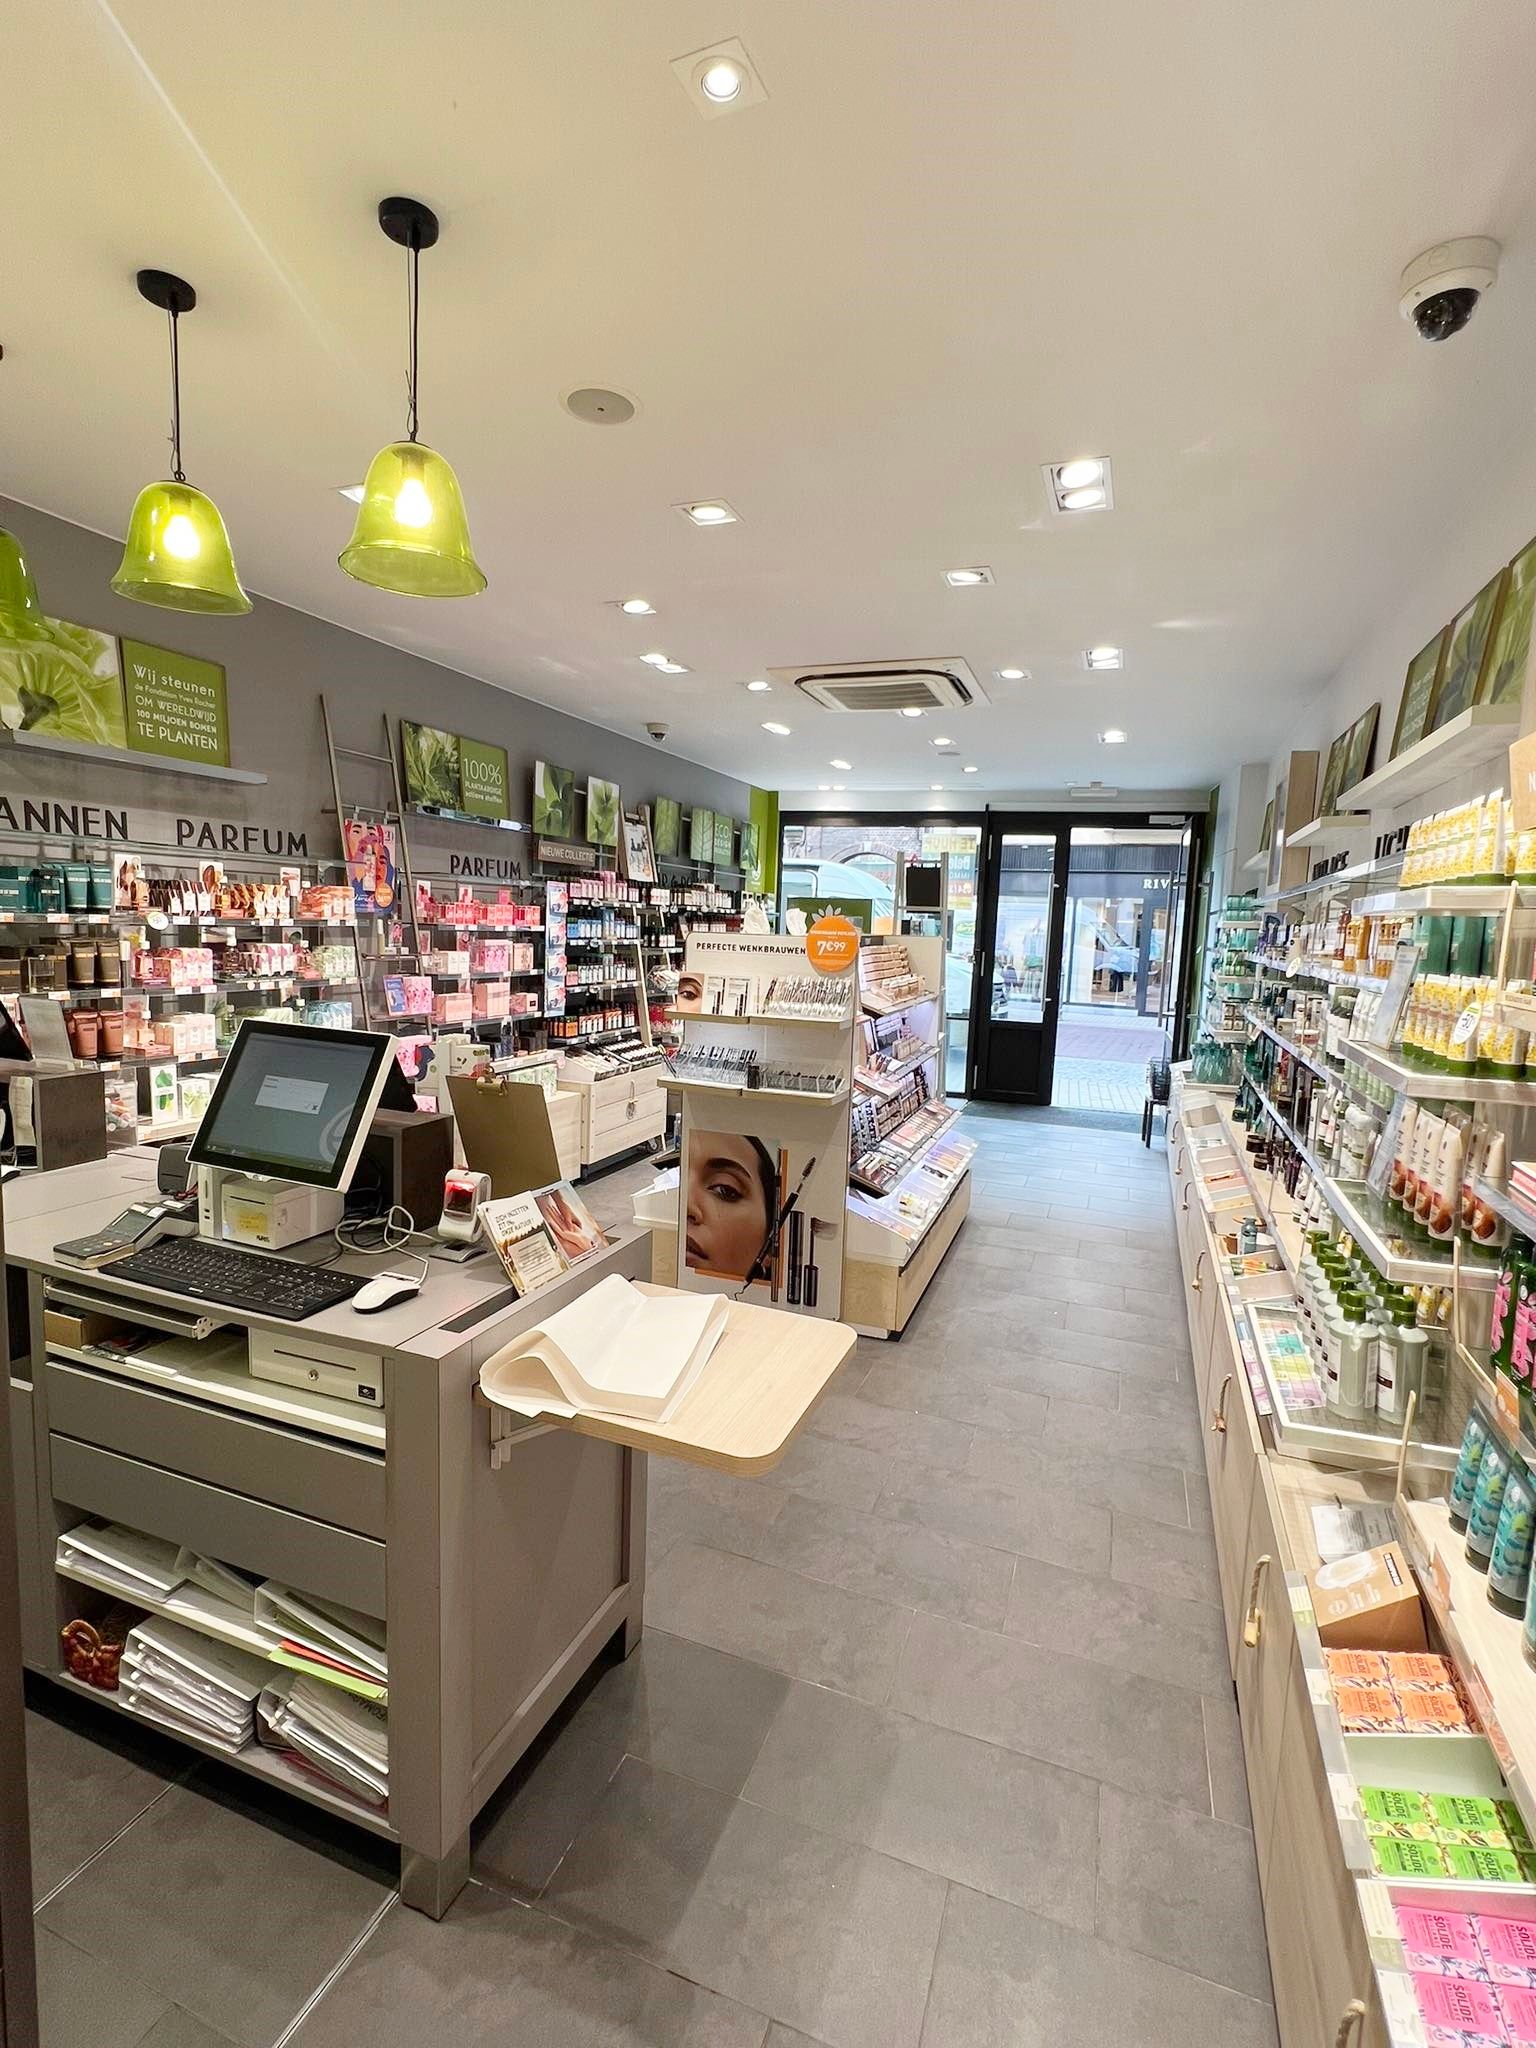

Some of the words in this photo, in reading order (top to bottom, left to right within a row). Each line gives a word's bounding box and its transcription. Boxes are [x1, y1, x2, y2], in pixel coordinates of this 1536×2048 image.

[133, 664, 155, 685] Wij
[161, 676, 215, 697] steunen
[135, 695, 153, 707] OM
[157, 700, 217, 723] WERELDWIJD
[136, 709, 150, 719] 100
[152, 713, 187, 727] MILJOEN
[189, 720, 217, 734] BOMEN
[137, 721, 155, 738] TE
[159, 726, 217, 750] PLANTEN
[464, 758, 502, 785] 100%
[176, 819, 308, 857] PARFUM
[714, 822, 729, 839] ECO
[450, 854, 520, 880] PARFUM
[696, 942, 736, 951] PERFECTE
[738, 944, 806, 955] WENKBRAUWEN
[1391, 1791, 1406, 1818] SOLIDE
[1461, 1799, 1480, 1826] SOLIDE
[1406, 1843, 1424, 1873] SOLIDE
[1481, 1851, 1501, 1881] SOLIDE
[1433, 1915, 1452, 1950] SOLIDE
[1515, 1925, 1536, 1960] SOLIDE
[1452, 1984, 1474, 2023] SOLIDE
